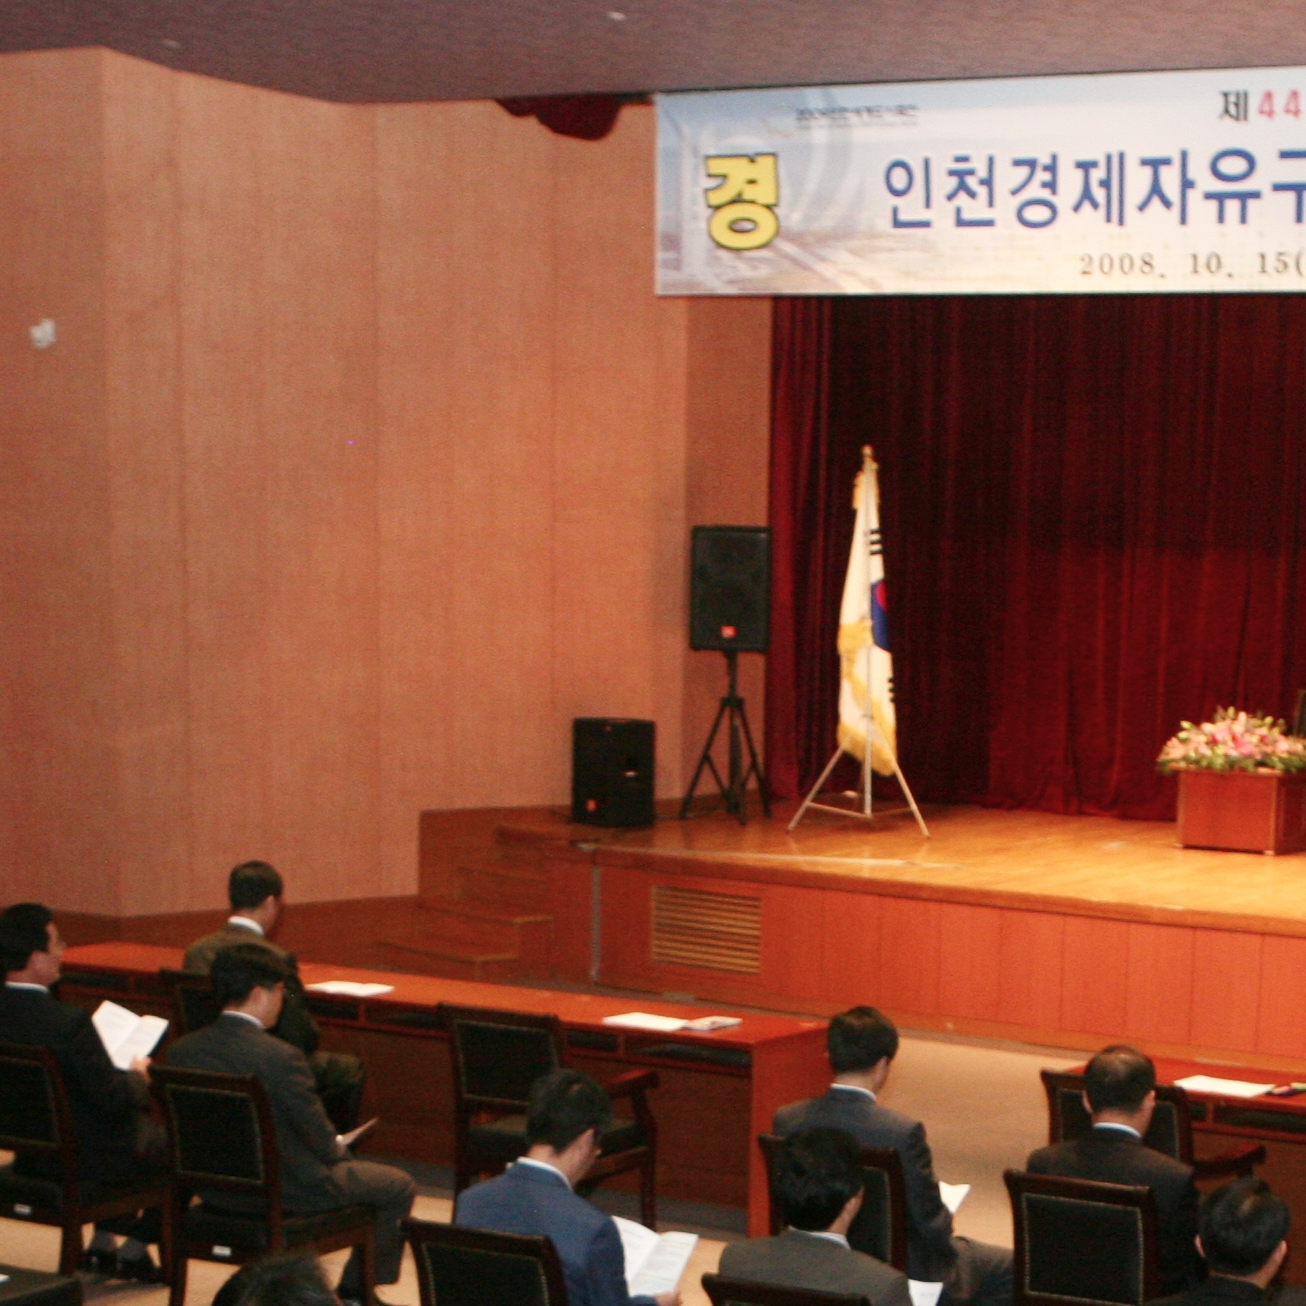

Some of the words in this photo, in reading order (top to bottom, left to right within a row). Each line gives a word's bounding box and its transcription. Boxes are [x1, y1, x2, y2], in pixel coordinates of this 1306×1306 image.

[703, 151, 779, 251] 경
[1080, 252, 1166, 279] 2008.
[1189, 252, 1234, 279] 10.
